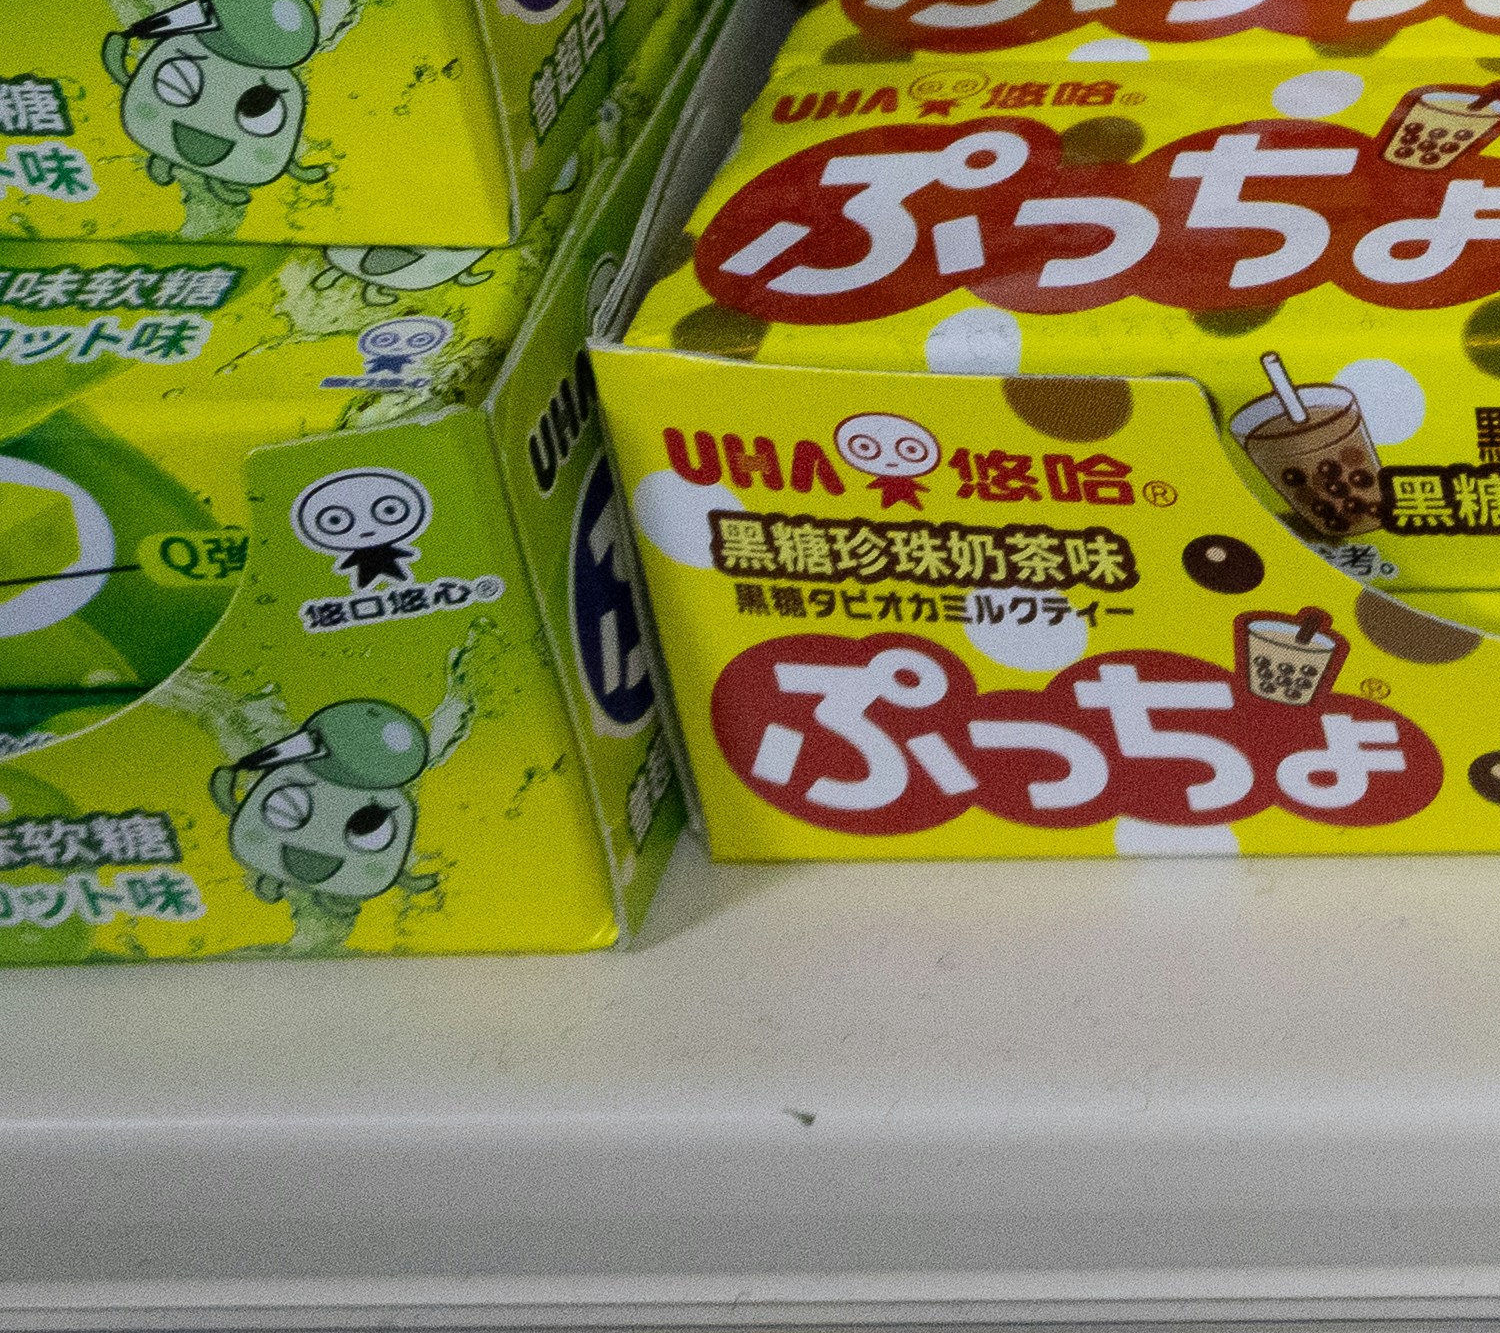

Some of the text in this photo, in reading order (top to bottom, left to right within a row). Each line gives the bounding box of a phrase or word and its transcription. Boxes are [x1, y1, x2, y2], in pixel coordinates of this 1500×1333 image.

[772, 80, 1120, 121] UHA 悠哈
[0, 269, 236, 306] 味软糖
[0, 321, 198, 358] ット味
[663, 427, 1135, 506] UHA 悠哈
[719, 522, 1127, 586] 黑糖珍珠奶茶味
[308, 580, 474, 629] 悠口悠心
[735, 584, 1135, 625] 黑糖タピオカミルクティー
[752, 648, 1407, 812] ぷっちょ
